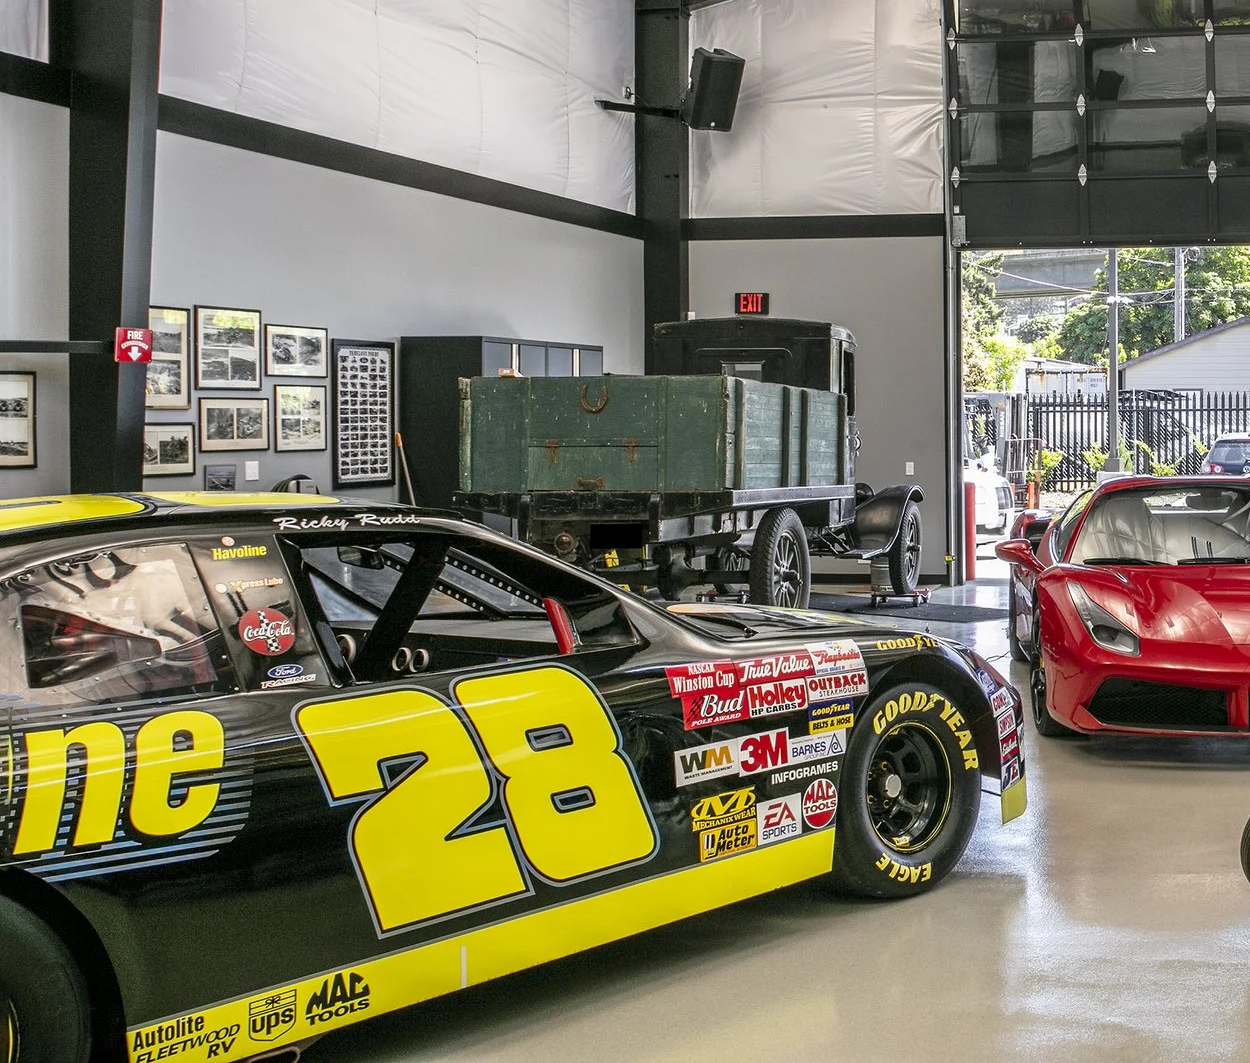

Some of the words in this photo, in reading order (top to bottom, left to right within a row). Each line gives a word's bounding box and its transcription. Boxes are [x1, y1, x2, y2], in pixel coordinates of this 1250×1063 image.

[740, 293, 763, 313] EXIT
[127, 330, 143, 340] FIRE
[273, 515, 349, 530] Ricky
[354, 513, 420, 526] Rudd
[212, 545, 267, 561] Havoline
[229, 578, 263, 594] Xpress
[264, 576, 283, 587] Lube
[876, 634, 939, 652] GOODYE
[687, 662, 715, 676] NASCAR
[261, 673, 316, 689] RACING
[673, 675, 714, 694] Winston
[715, 670, 735, 688] Cup
[809, 672, 865, 692] OUTBACK
[749, 682, 807, 708] Holley
[819, 685, 859, 698] STEAKHOUSE
[700, 690, 745, 718] Bud
[751, 707, 764, 717] HP
[766, 702, 797, 714] CARBS
[811, 703, 850, 717] GOODYEAR
[691, 718, 713, 727] POLE
[714, 713, 742, 723] AWARD
[812, 720, 829, 731] BELTS
[830, 719, 835, 727] &
[836, 716, 851, 726] HOSE
[872, 690, 980, 771] GOODYEAR
[680, 745, 733, 774] WM
[740, 730, 789, 773] 3M
[792, 741, 827, 758] BARNES
[701, 765, 733, 777] MANAGEMENT
[771, 761, 839, 785] INFOGRAMES
[8, 711, 225, 856] ne
[803, 779, 837, 806] MAC
[292, 662, 659, 936] 28
[804, 800, 837, 814] TOOLS
[692, 816, 734, 832] MECHANIX
[733, 806, 757, 821] WEAR
[763, 801, 796, 830] EA
[718, 824, 749, 842] Auto
[762, 822, 797, 841] SPORTS
[716, 834, 755, 853] Meter
[875, 852, 932, 883] EAGLE
[305, 971, 371, 1016] MAC
[250, 1007, 295, 1036] ups
[305, 997, 371, 1026] TOOLS
[133, 1014, 205, 1052] Autolite
[135, 1023, 241, 1063] FLEETWOOD
[206, 1037, 237, 1059] RV
